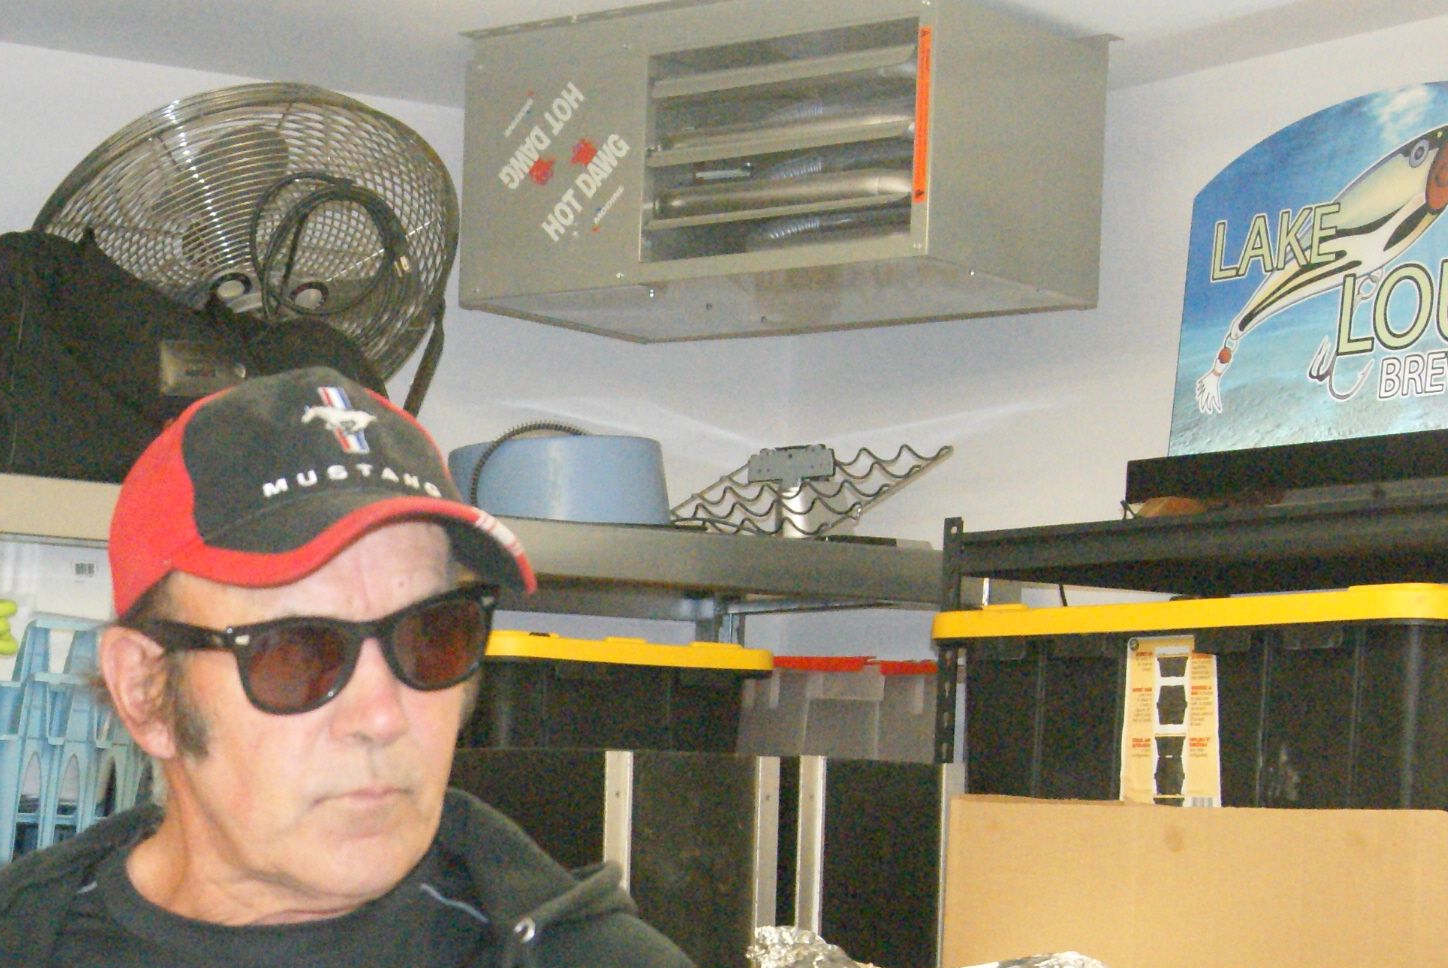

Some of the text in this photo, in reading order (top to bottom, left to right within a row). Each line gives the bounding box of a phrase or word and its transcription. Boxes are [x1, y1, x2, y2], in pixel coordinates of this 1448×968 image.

[544, 82, 585, 137] HOT
[498, 125, 552, 190] DAWG
[541, 133, 631, 242] HOT DAWG
[1210, 201, 1342, 283] LAKE
[1335, 257, 1448, 357] LO
[1377, 350, 1448, 400] BRE
[263, 463, 442, 498] MUSTANG
